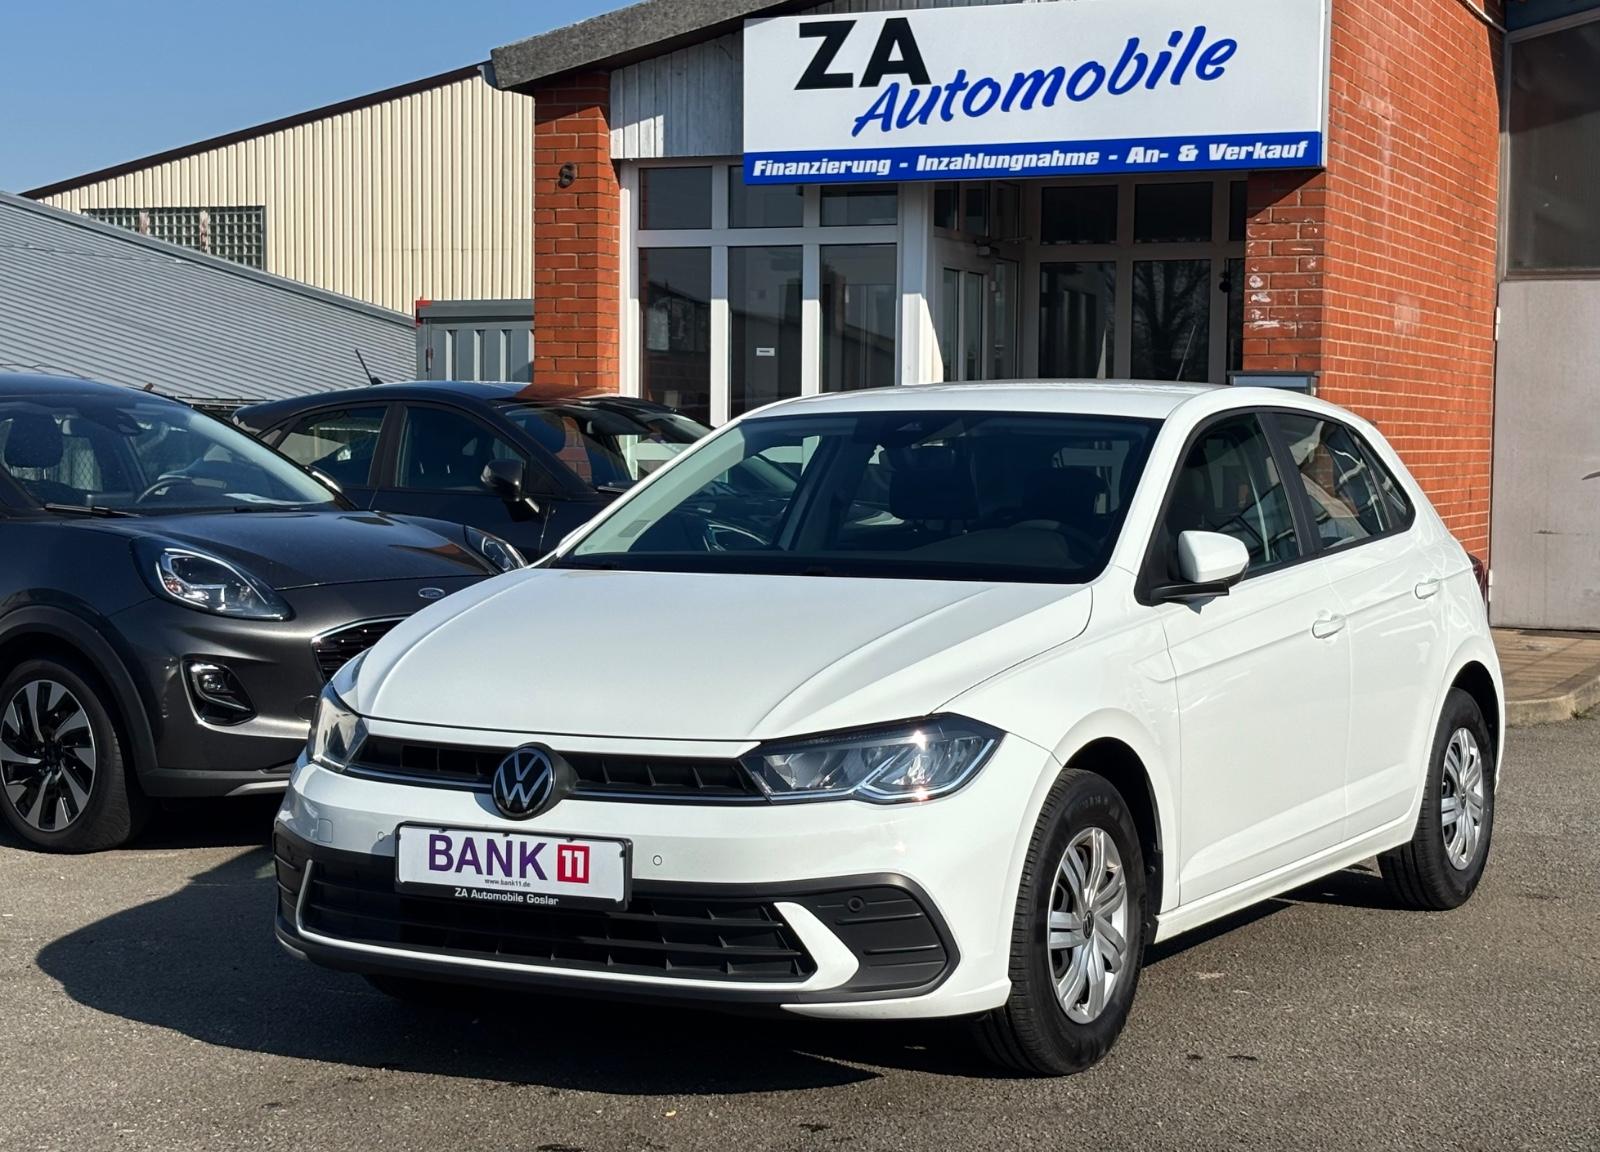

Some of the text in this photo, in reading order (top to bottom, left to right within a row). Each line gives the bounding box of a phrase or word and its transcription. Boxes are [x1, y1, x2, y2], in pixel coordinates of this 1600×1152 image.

[794, 17, 932, 90] ZA
[851, 26, 1238, 137] Automobile
[753, 158, 892, 177] Finanzierung
[916, 150, 1099, 171] Inzahlungnahme
[1126, 146, 1169, 164] An-
[1178, 145, 1199, 162] &
[1208, 140, 1309, 161] Verkauf
[429, 833, 586, 880] BANK 11
[455, 887, 559, 905] ZA Automobile Goslar
[484, 878, 531, 888] www.bank11.de
